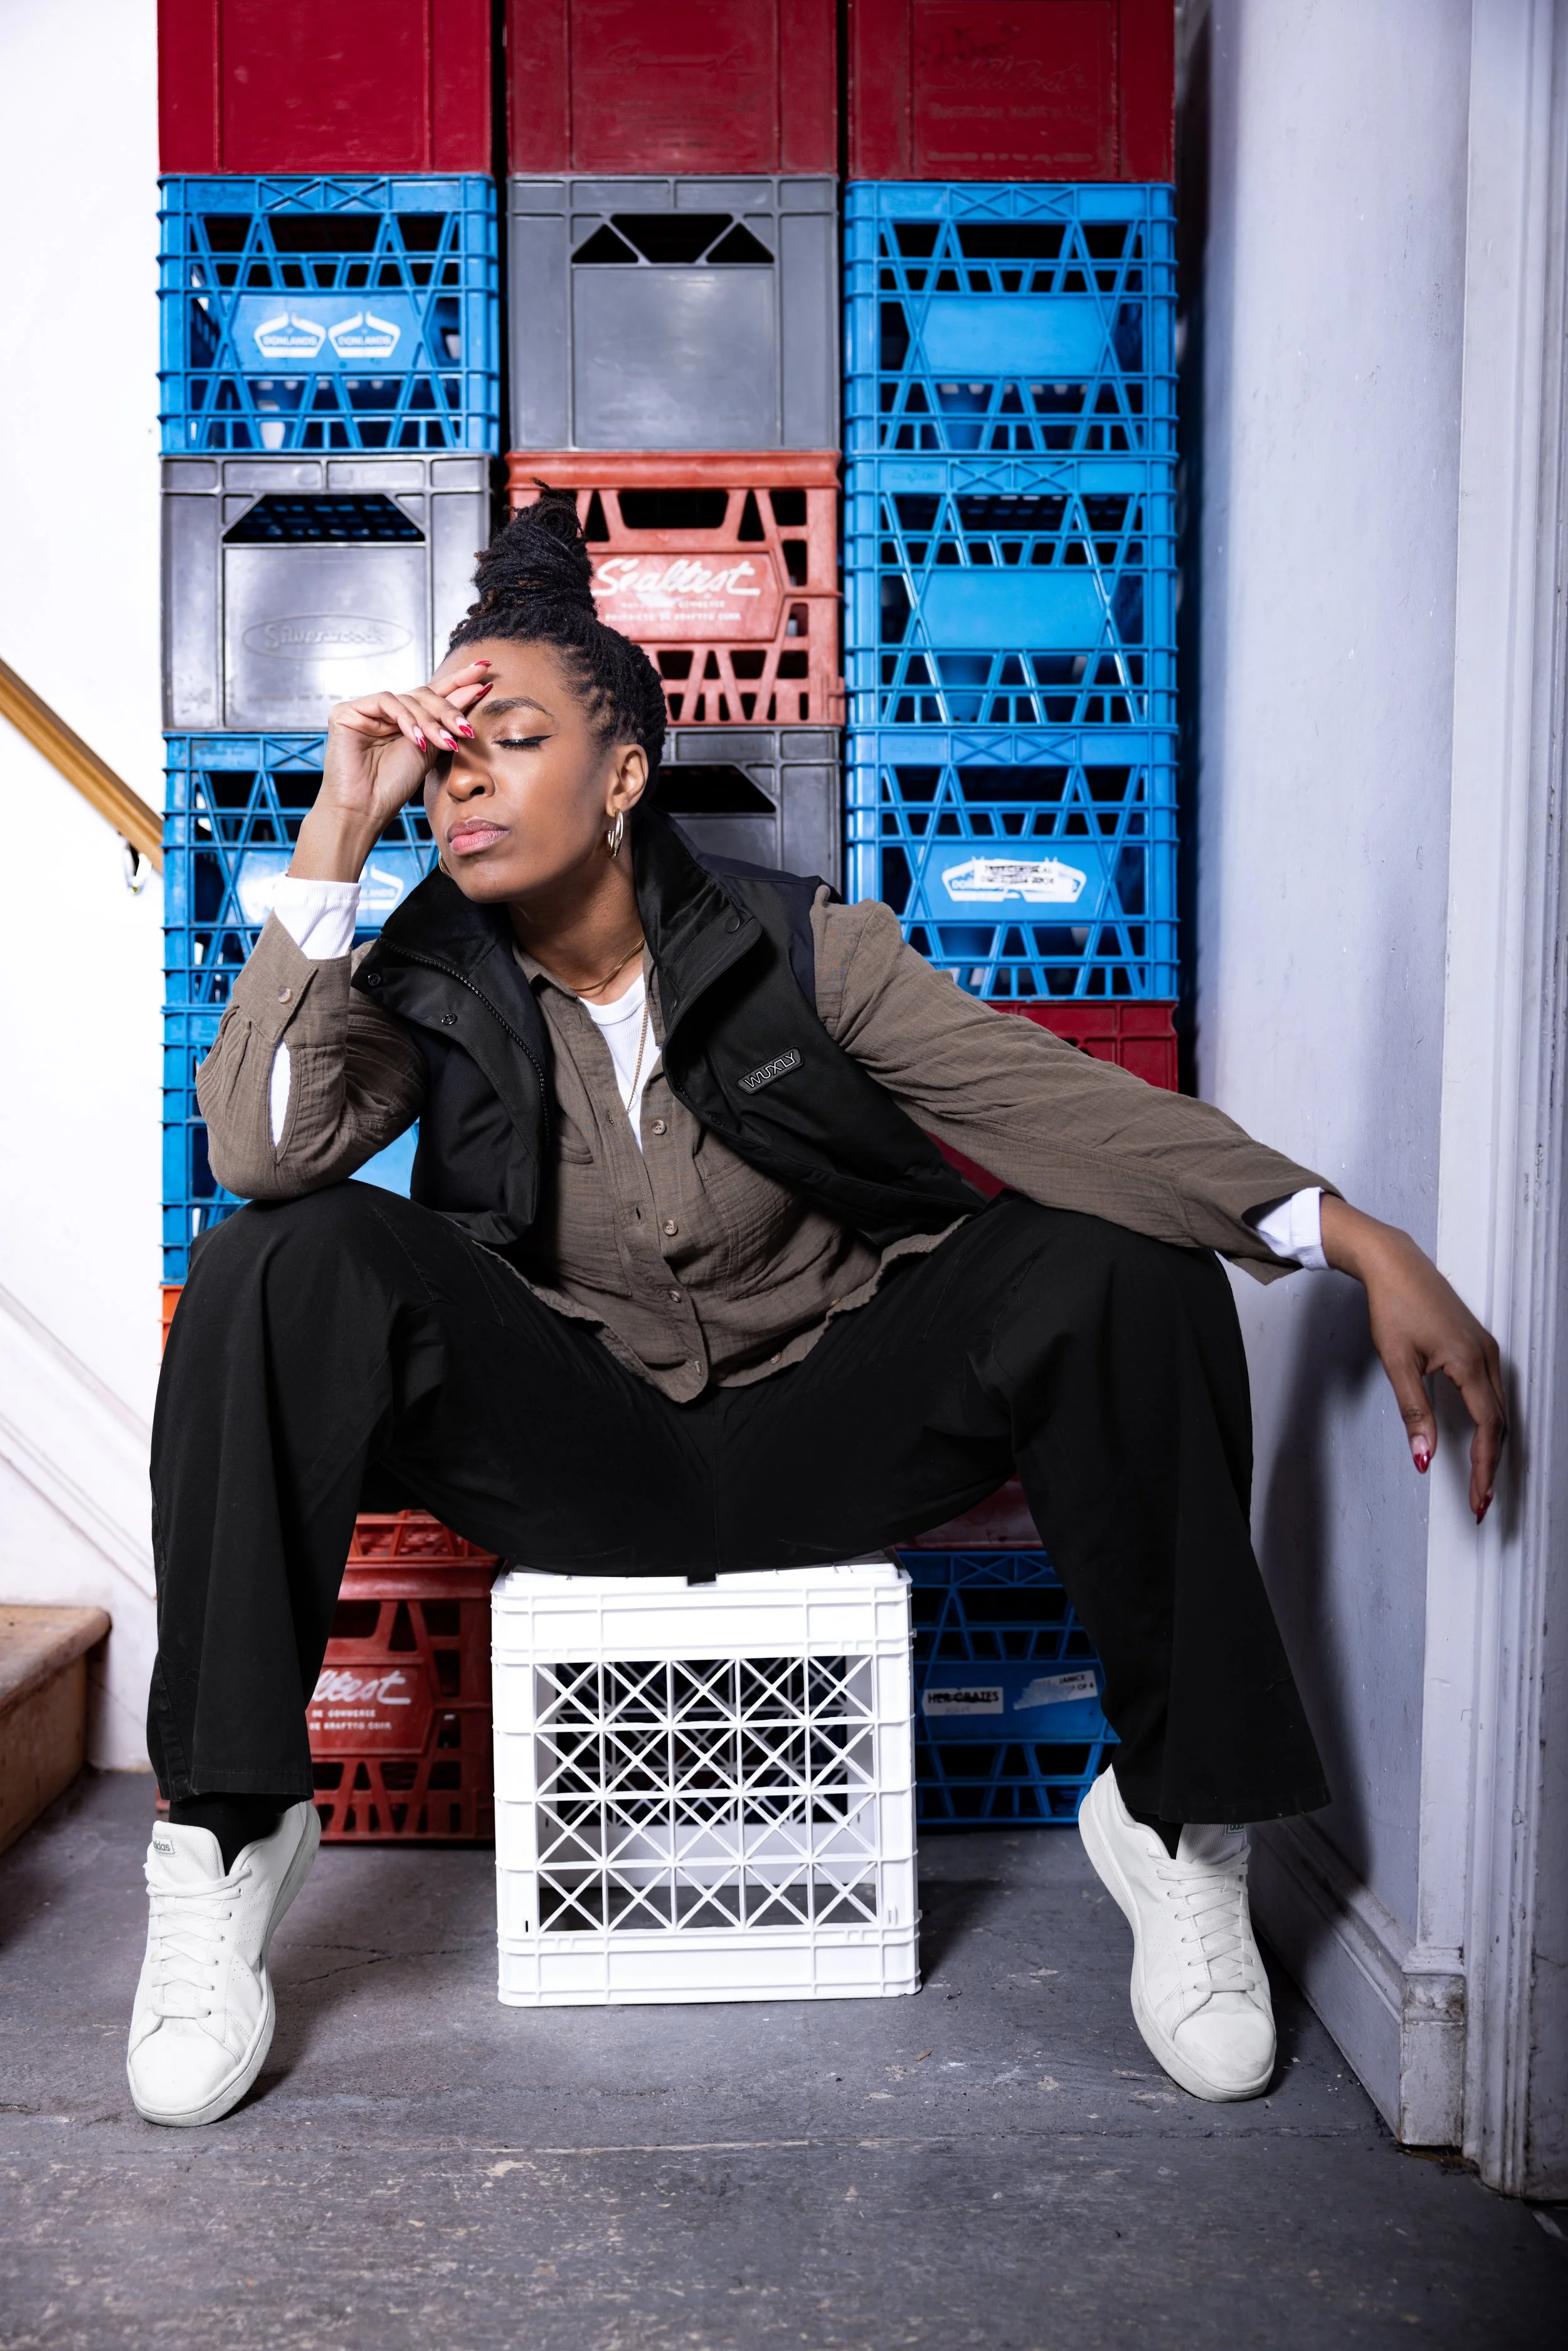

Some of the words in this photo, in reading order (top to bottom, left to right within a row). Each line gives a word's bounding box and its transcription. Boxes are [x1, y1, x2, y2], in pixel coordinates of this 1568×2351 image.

[590, 558, 761, 597] Sealtest
[743, 1050, 798, 1088] WUXLY
[310, 1669, 411, 1705] ltest
